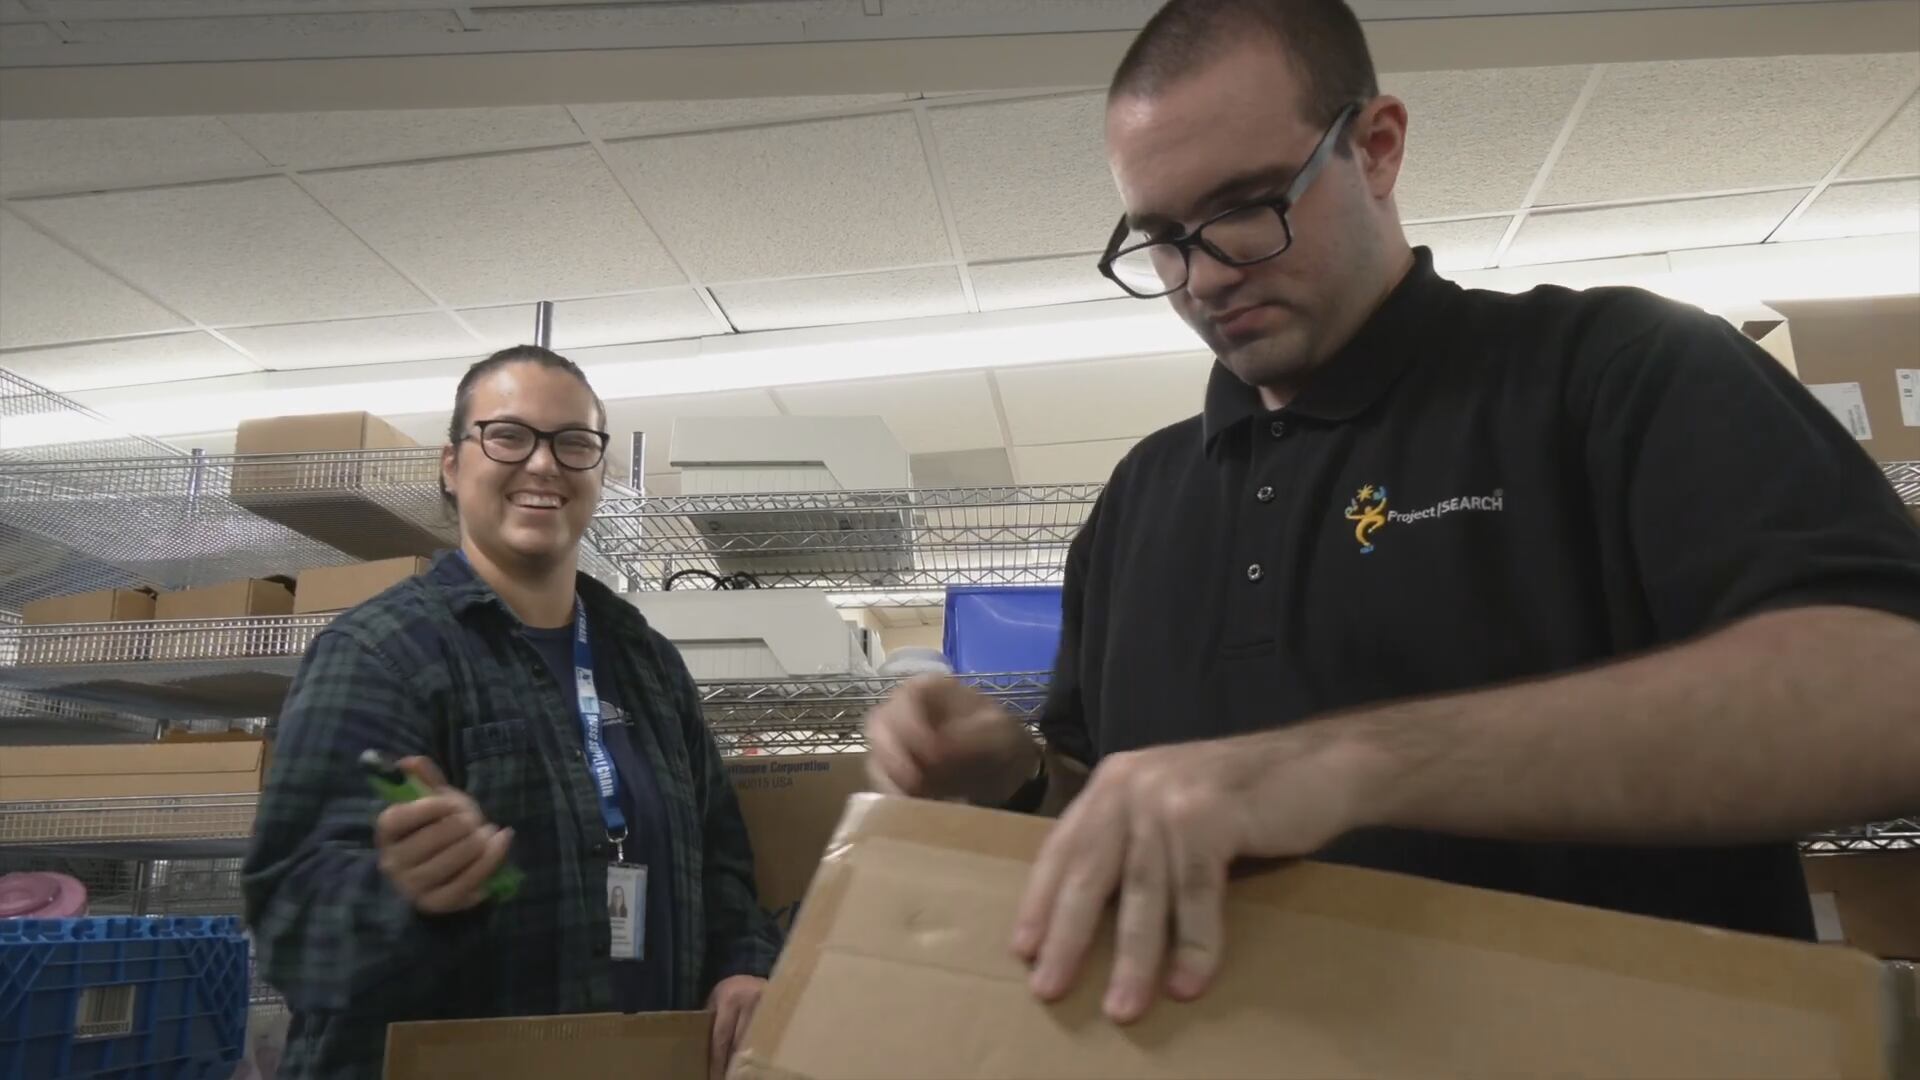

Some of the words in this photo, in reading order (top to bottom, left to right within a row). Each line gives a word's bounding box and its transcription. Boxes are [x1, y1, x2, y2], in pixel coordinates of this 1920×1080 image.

[770, 760, 830, 775] Corporation
[597, 766, 615, 797] CHAIN
[772, 776, 794, 789] USA
